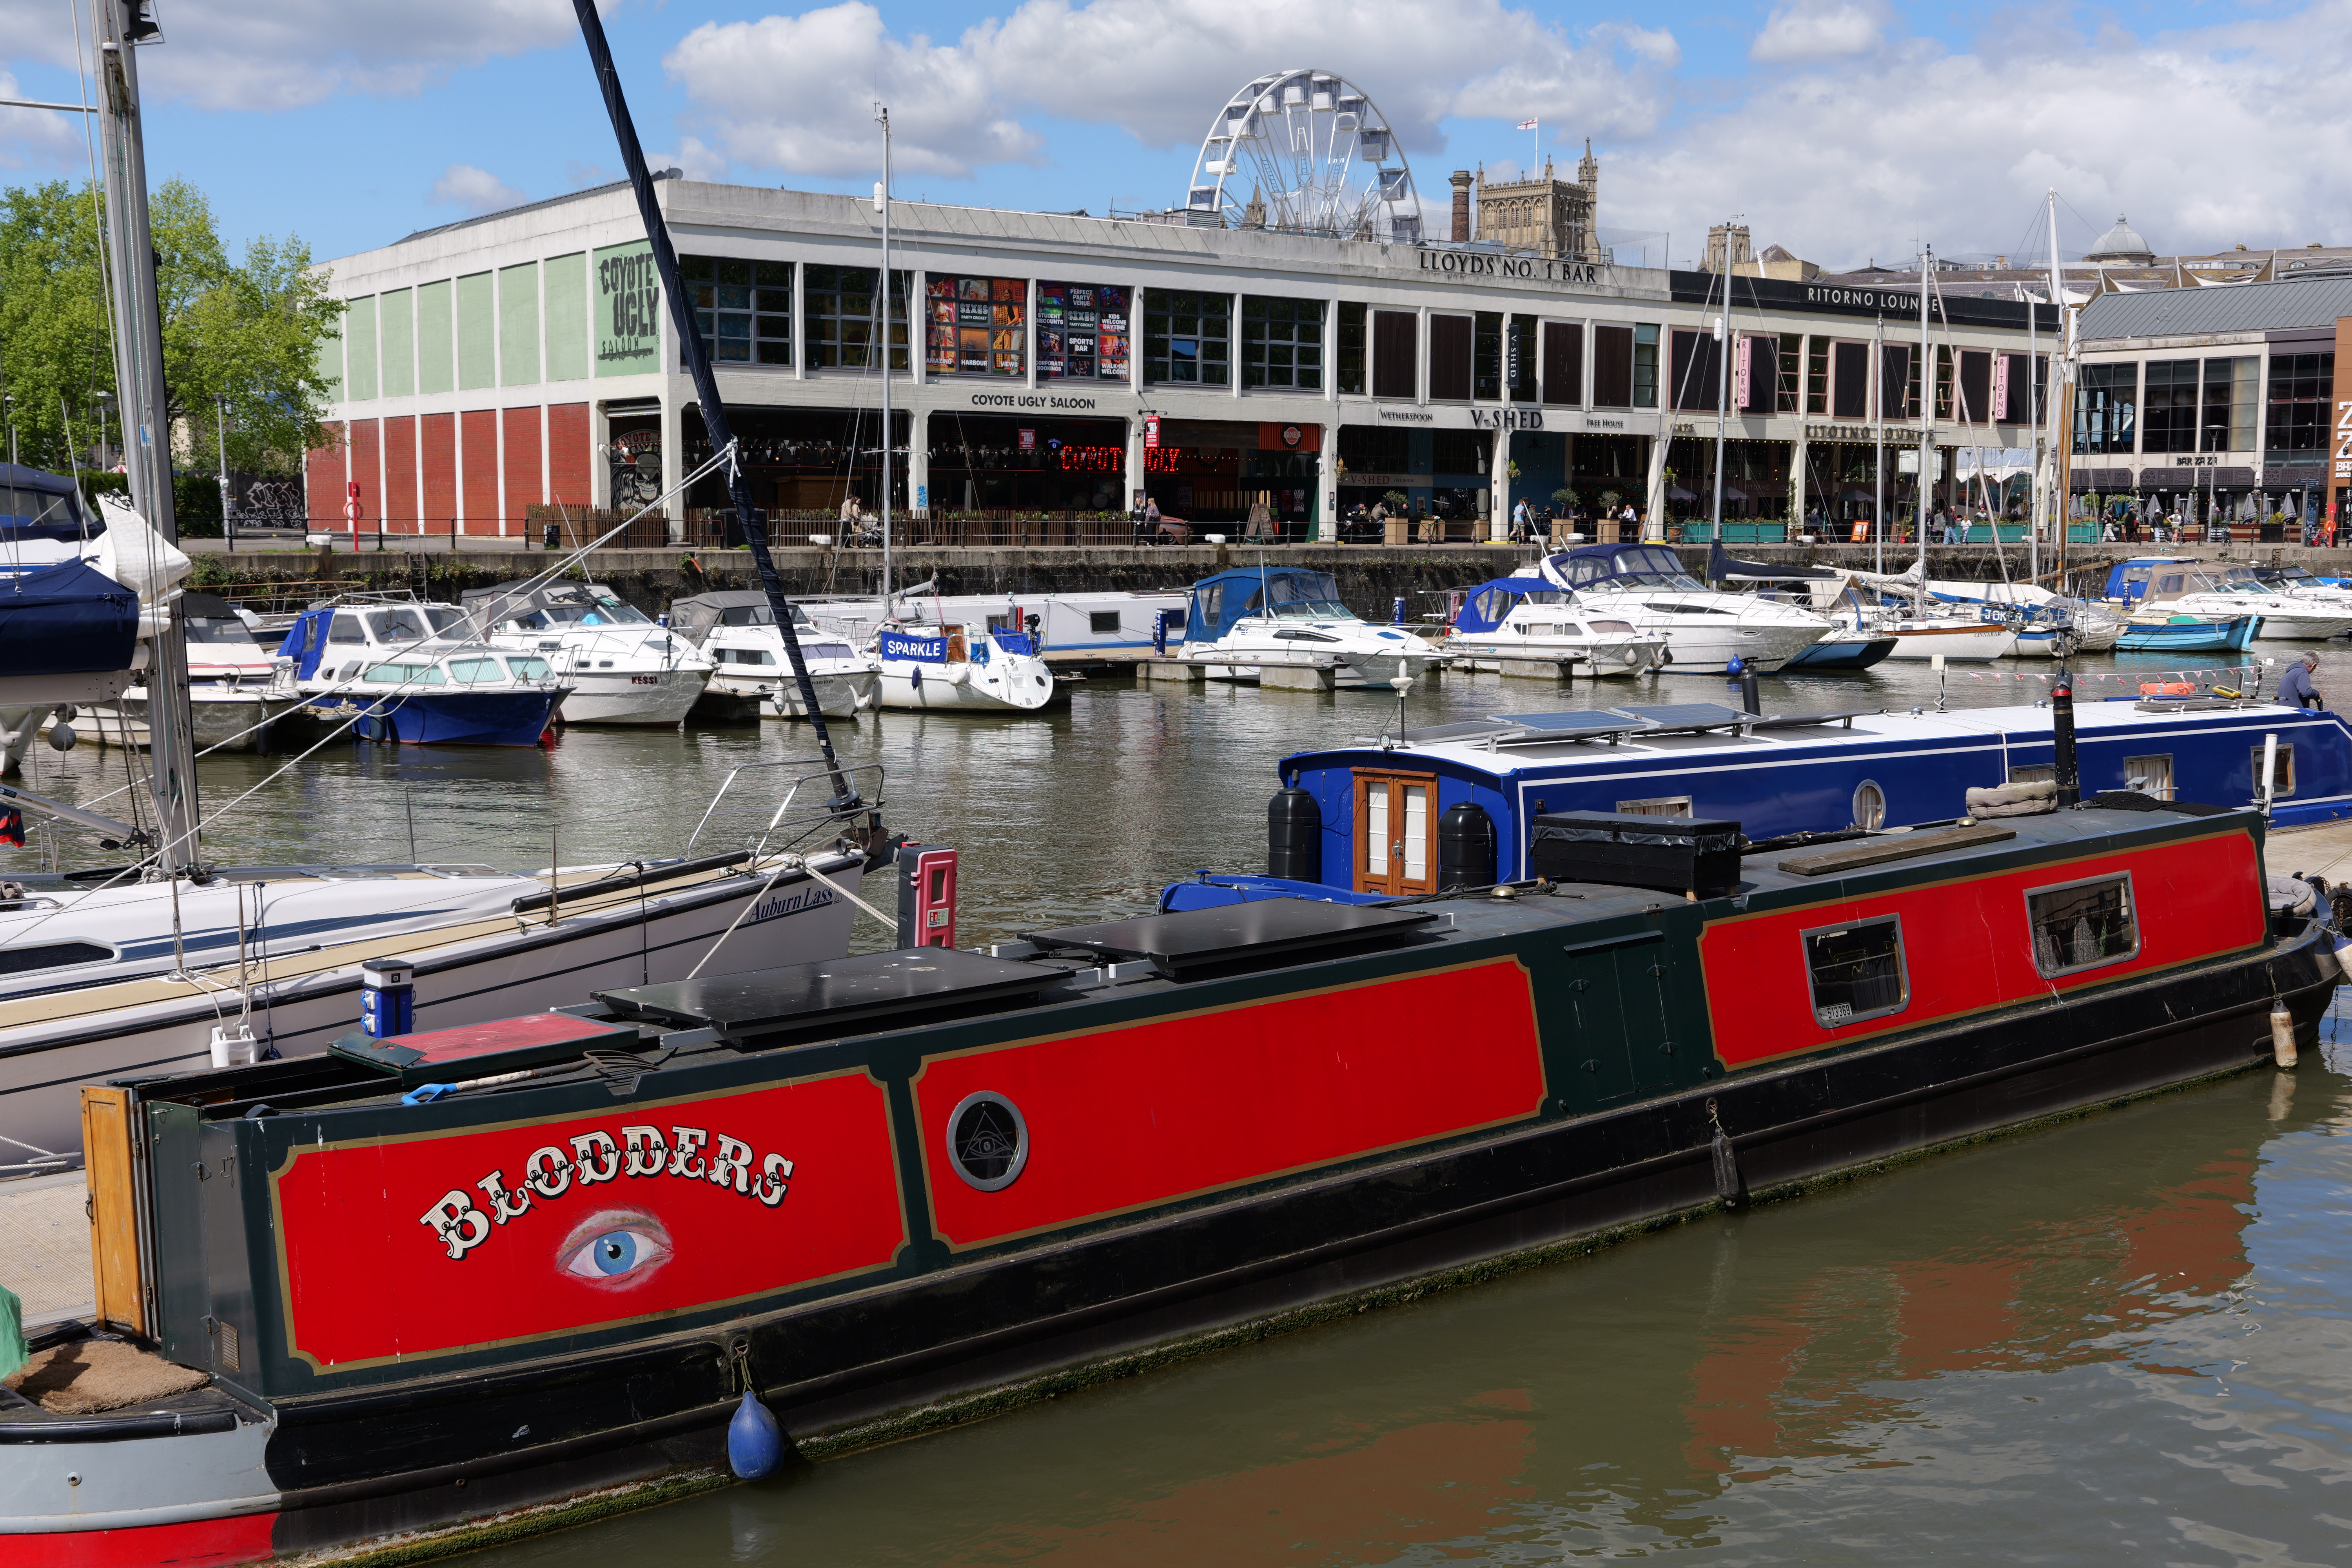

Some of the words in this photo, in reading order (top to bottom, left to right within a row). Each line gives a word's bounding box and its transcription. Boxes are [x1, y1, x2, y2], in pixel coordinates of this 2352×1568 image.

[599, 253, 653, 294] COYOTE
[1420, 251, 1494, 274] LLOYDS
[1504, 259, 1536, 277] NO.
[1546, 262, 1552, 279] 1
[1563, 263, 1596, 282] BAR
[1808, 287, 1873, 306] RITORNO
[1881, 294, 1938, 312] LOUNE
[613, 287, 659, 338] UGLY
[960, 303, 988, 314] SIXES
[1068, 311, 1095, 321] SIXES
[972, 394, 1014, 406] COYOTE
[1018, 396, 1047, 407] UGLY
[1050, 397, 1095, 409] SALOON
[1470, 410, 1543, 428] V-SHED
[1602, 419, 1624, 427] HOUSE
[615, 432, 651, 450] COYOTE
[1805, 425, 1870, 439] RITORNO
[1885, 427, 1934, 441] OUNE
[1062, 446, 1124, 470] COYOT
[1351, 475, 1390, 485] V-SHED
[888, 641, 940, 656] SPARKLE
[632, 676, 658, 684] KESSI
[748, 895, 801, 922] Auburn
[802, 887, 833, 908] Lass
[1827, 1004, 1850, 1019] 513369
[418, 1125, 795, 1261] BLODDERS
